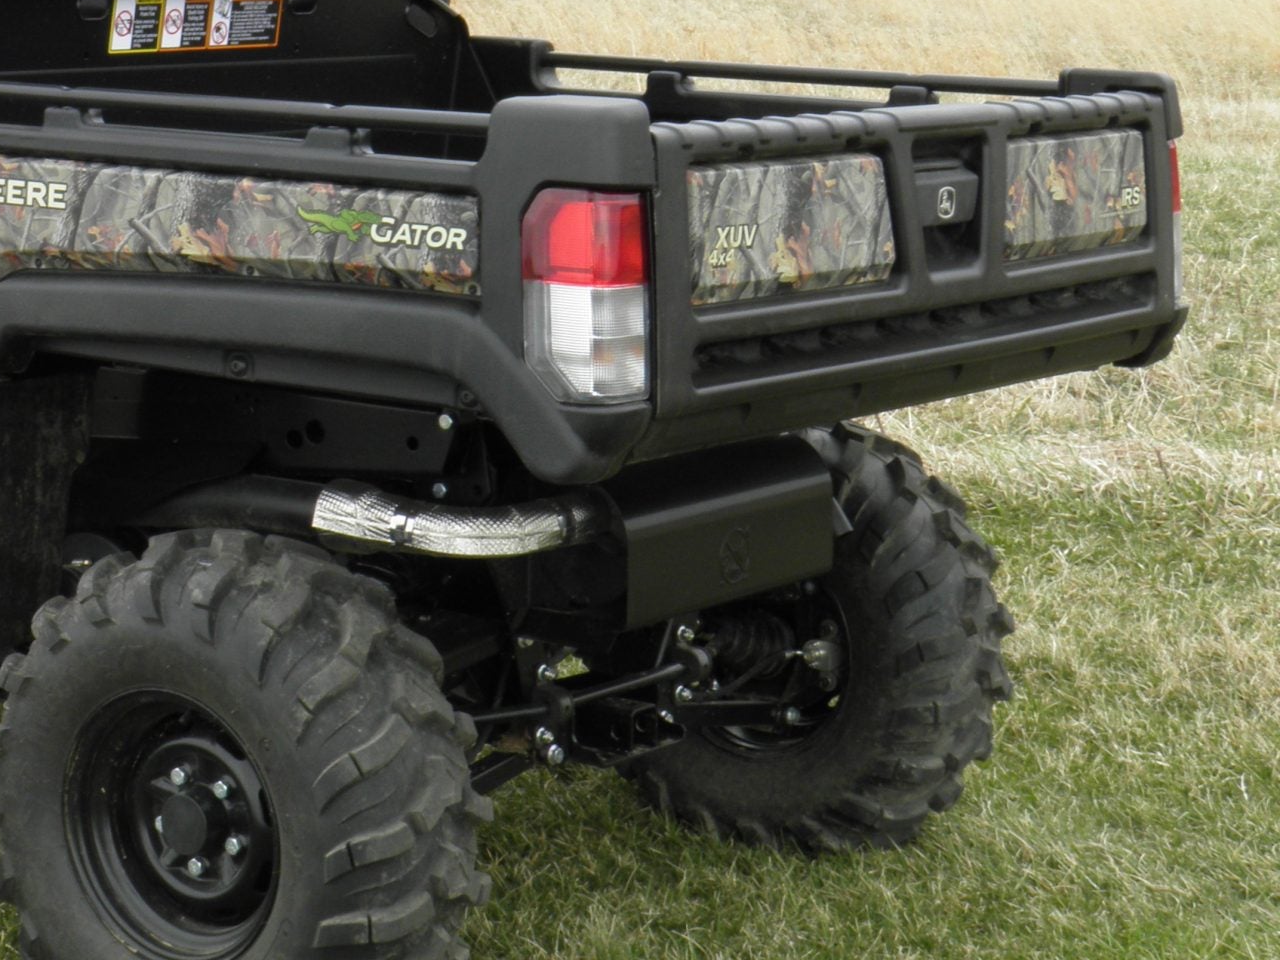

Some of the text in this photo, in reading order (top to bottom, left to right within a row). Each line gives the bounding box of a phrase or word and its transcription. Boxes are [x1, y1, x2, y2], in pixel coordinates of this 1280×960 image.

[370, 216, 467, 250] GATOR
[715, 224, 758, 249] XUV
[708, 248, 736, 266] 4x4
